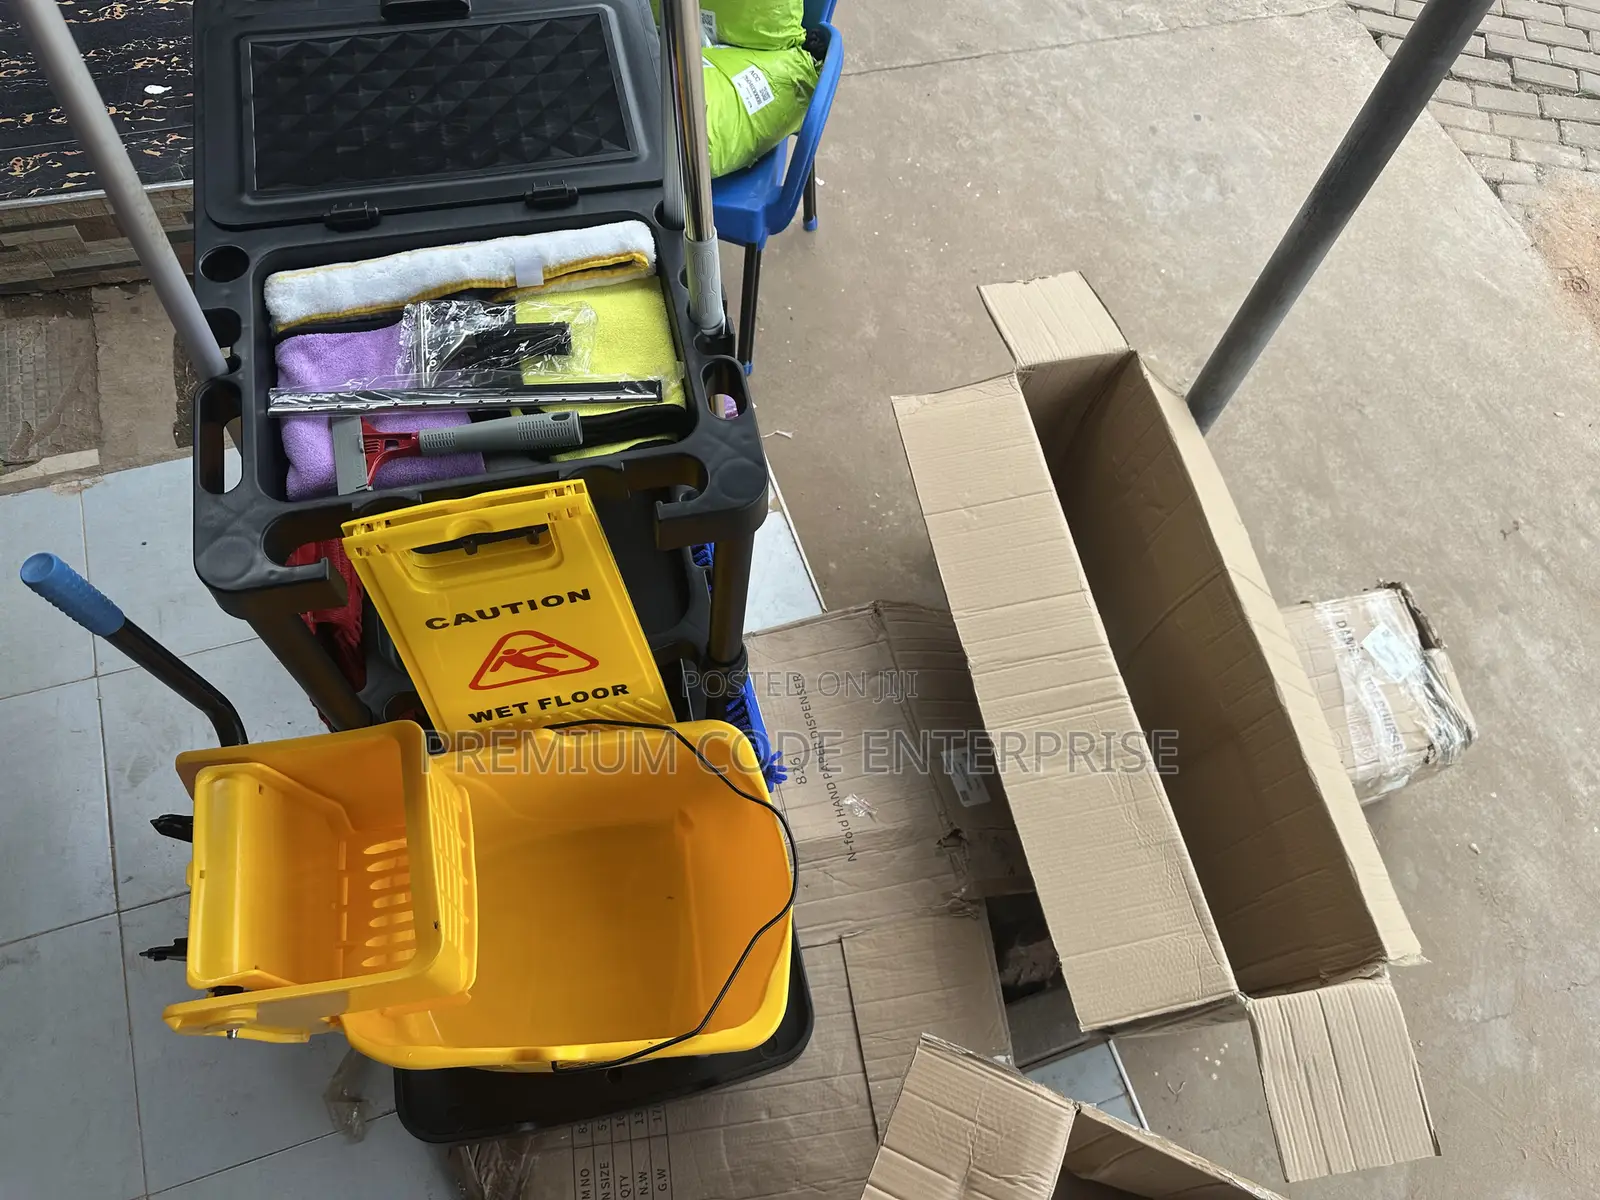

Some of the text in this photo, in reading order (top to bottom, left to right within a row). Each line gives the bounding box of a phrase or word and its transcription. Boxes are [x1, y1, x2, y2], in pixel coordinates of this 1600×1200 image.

[425, 588, 592, 630] CAUTION
[468, 684, 630, 724] WET FLOOR
[790, 757, 807, 785] 826
[792, 673, 857, 862] N-fold HAND PAPER DISPENSER
[580, 1168, 591, 1187] NO
[600, 1161, 610, 1190] SIZE
[619, 1174, 632, 1199] QTY
[638, 1171, 648, 1196] N.W
[656, 1168, 667, 1192] G.W
